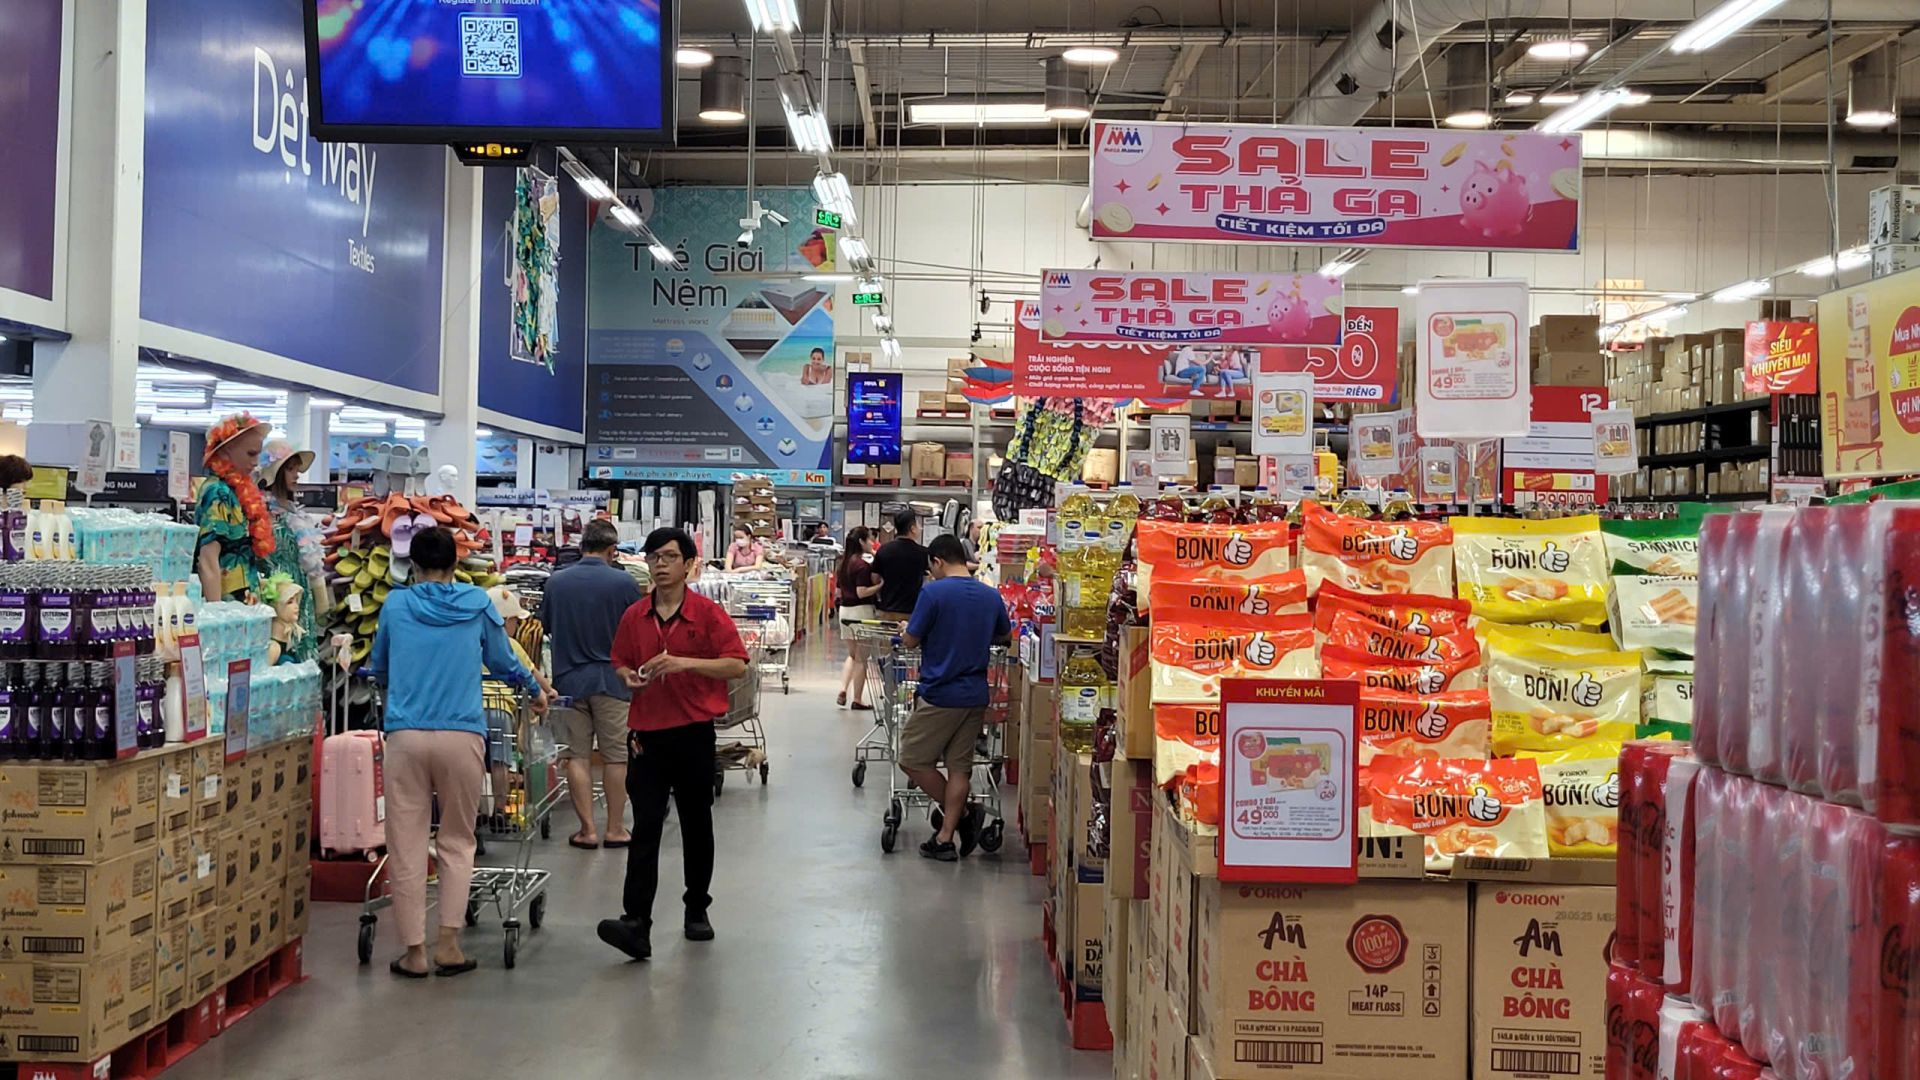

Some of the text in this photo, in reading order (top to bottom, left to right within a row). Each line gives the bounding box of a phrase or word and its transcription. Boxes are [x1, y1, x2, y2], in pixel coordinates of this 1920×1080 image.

[253, 46, 311, 184] Dệt
[1172, 136, 1429, 180] SALE
[322, 142, 377, 237] May
[1180, 176, 1421, 217] THẢ GA
[1892, 191, 1901, 238] Professional
[1218, 217, 1384, 237] TIẾT KIỆM TỐI ĐA
[348, 239, 375, 273] Textiles
[653, 279, 727, 311] Nệm
[1089, 277, 1248, 304] SALE
[1094, 302, 1244, 326] THẢ GA
[1347, 315, 1373, 331] ĐẾN
[1118, 326, 1221, 340] TIẾT KIỆM TỐI ĐA
[1894, 327, 1910, 343] Mua
[1770, 338, 1792, 354] SIÊU
[1028, 364, 1051, 374] CUỘC
[1052, 364, 1074, 373] SỐNG
[1075, 365, 1091, 374] TIỆN
[1345, 386, 1377, 396] RIÊNG
[1432, 376, 1453, 389] 49
[1580, 393, 1602, 413] 12
[1896, 397, 1910, 418] Lợi
[117, 481, 137, 489] NAM
[805, 472, 825, 483] Km
[1176, 537, 1220, 561] BON!
[1343, 534, 1386, 555] BON!
[1491, 548, 1537, 569] BON!
[1035, 606, 1055, 616] OMO
[1194, 637, 1241, 660] BON!
[1369, 631, 1414, 659] BON!
[1256, 685, 1325, 698] KHUYẾN MÃI
[1524, 674, 1569, 702] BON!
[1364, 708, 1412, 733] BON!
[1543, 783, 1589, 806] BON!
[1413, 793, 1464, 818] BON!
[1236, 809, 1262, 825] 49
[1263, 810, 1279, 819] 000
[1255, 887, 1303, 899] ORION
[1511, 893, 1560, 906] ORION
[1362, 932, 1393, 953] 100%
[1256, 955, 1309, 982] CHÀ
[1511, 962, 1564, 990] CHÀ
[1248, 985, 1315, 1012] BÔNG
[1364, 984, 1388, 998] 14P
[1351, 1001, 1401, 1012] MEAT FLOSS
[1503, 992, 1570, 1020] BÔNG
